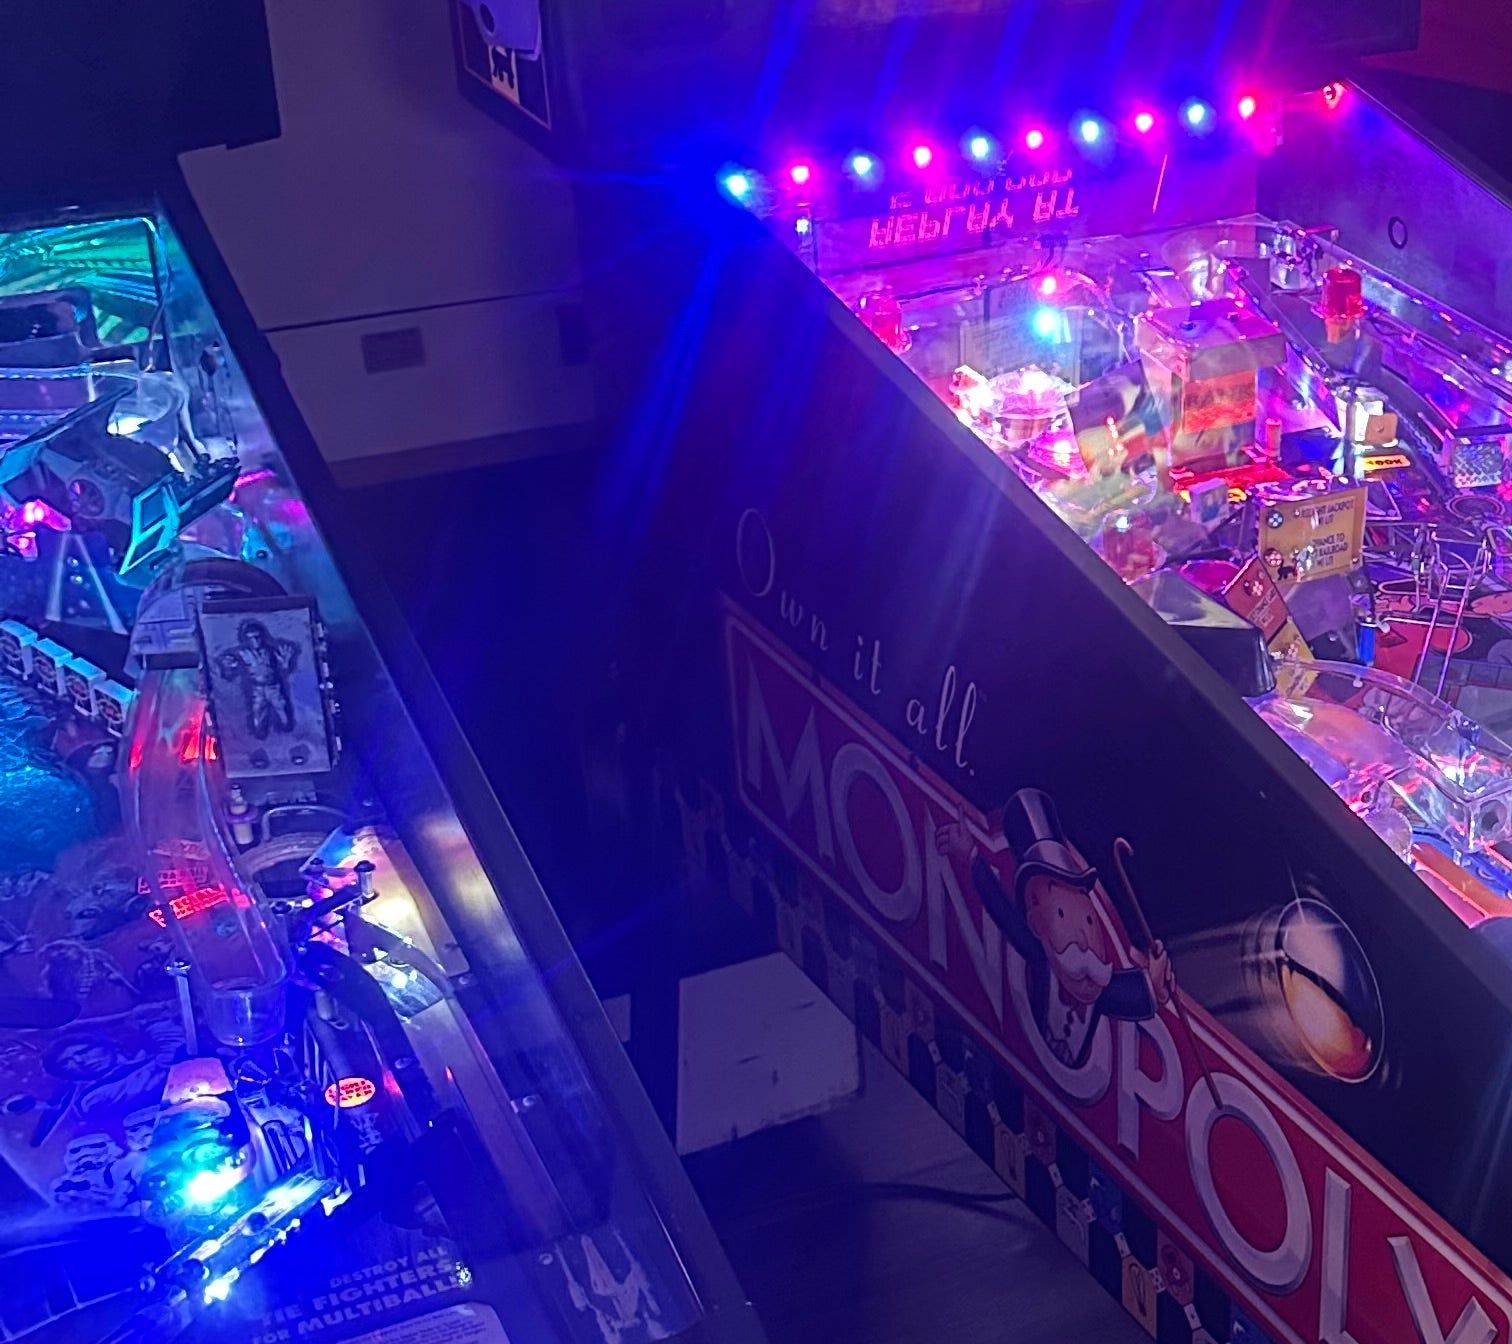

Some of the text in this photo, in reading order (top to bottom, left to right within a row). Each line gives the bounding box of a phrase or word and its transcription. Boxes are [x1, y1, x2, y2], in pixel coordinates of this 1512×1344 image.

[736, 507, 829, 652] Own
[853, 634, 882, 695] it
[312, 1258, 453, 1311] FIGHTERS
[330, 1245, 449, 1288] DESTROY ALL
